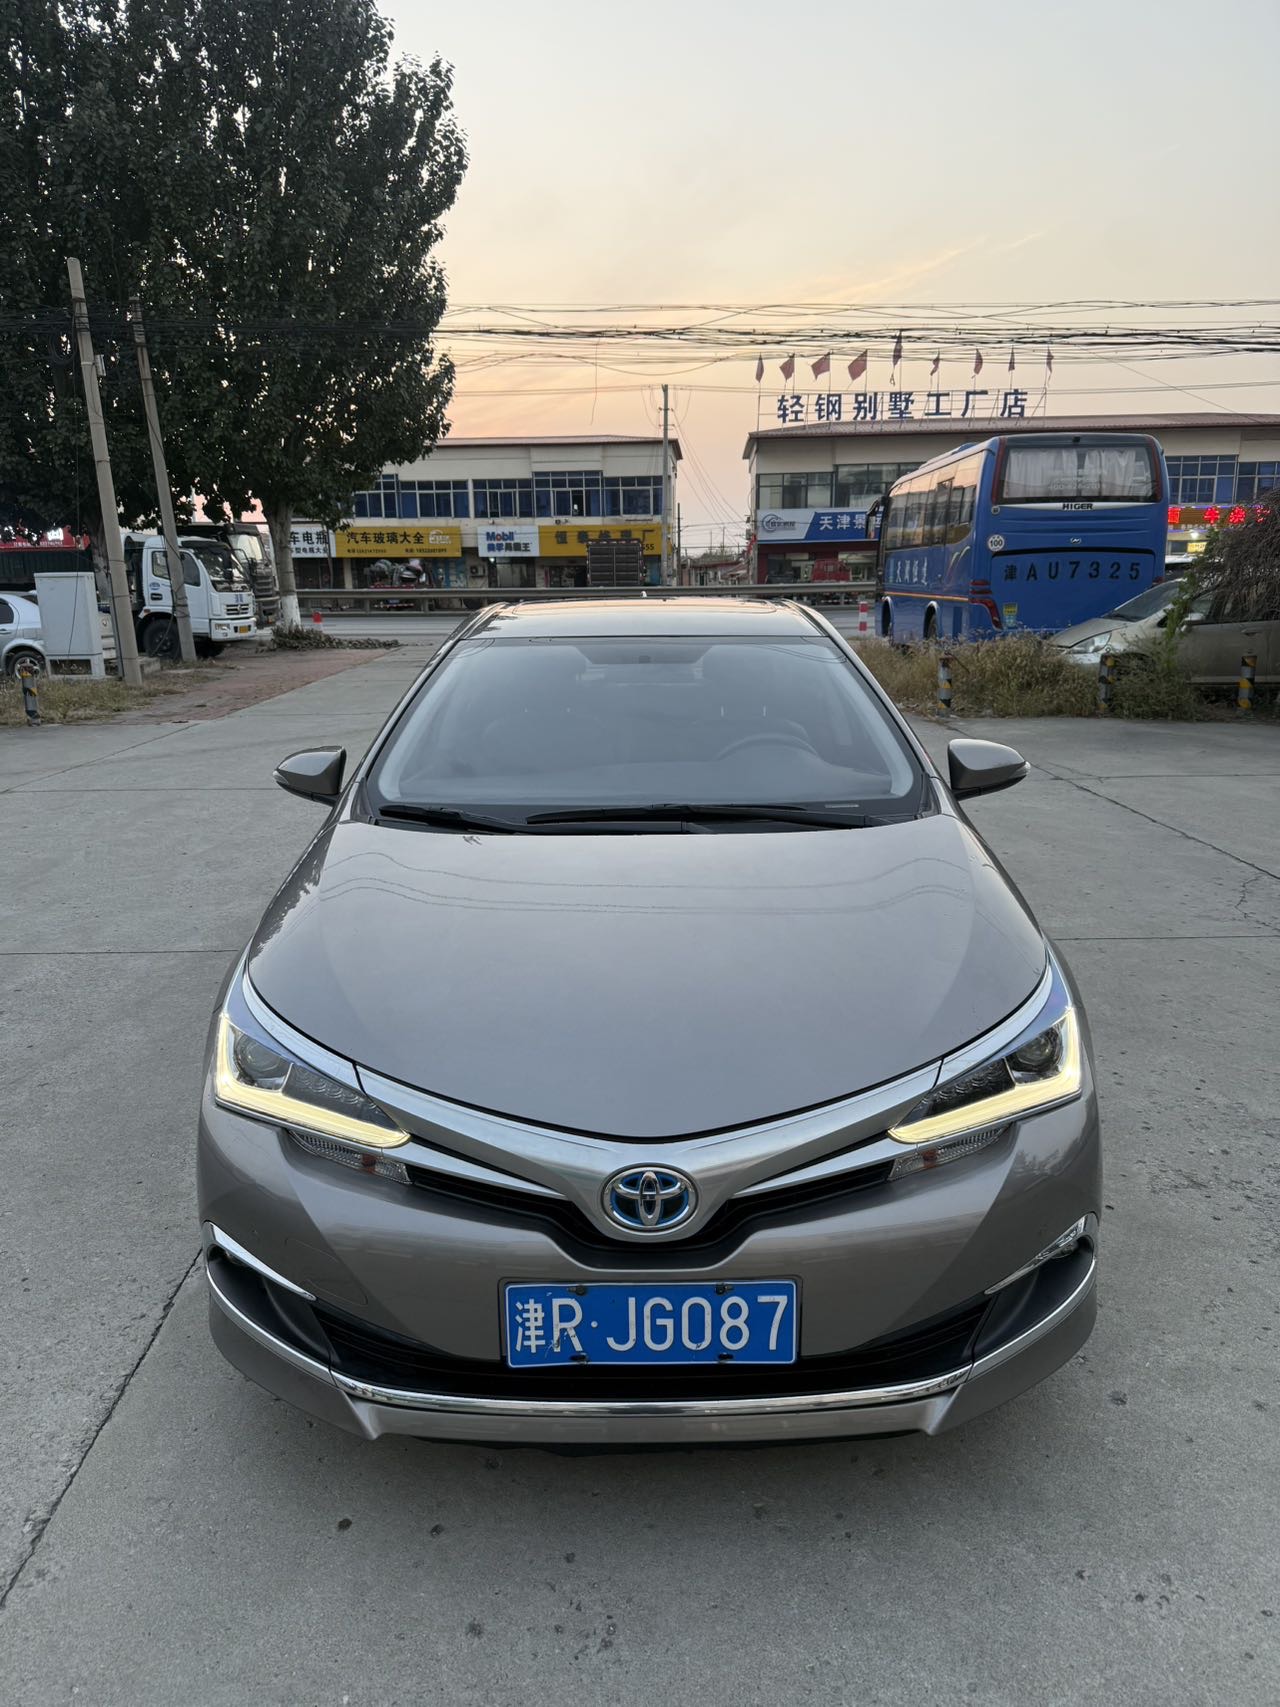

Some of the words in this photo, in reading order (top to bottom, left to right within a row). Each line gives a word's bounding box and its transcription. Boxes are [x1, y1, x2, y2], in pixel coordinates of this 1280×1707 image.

[777, 389, 1028, 423] 轻钢别墅工厂店
[346, 531, 424, 544] 汽车玻璃大全
[486, 532, 514, 541] Mobil
[990, 538, 1003, 547] 100
[1004, 561, 1140, 581] 津AU7325
